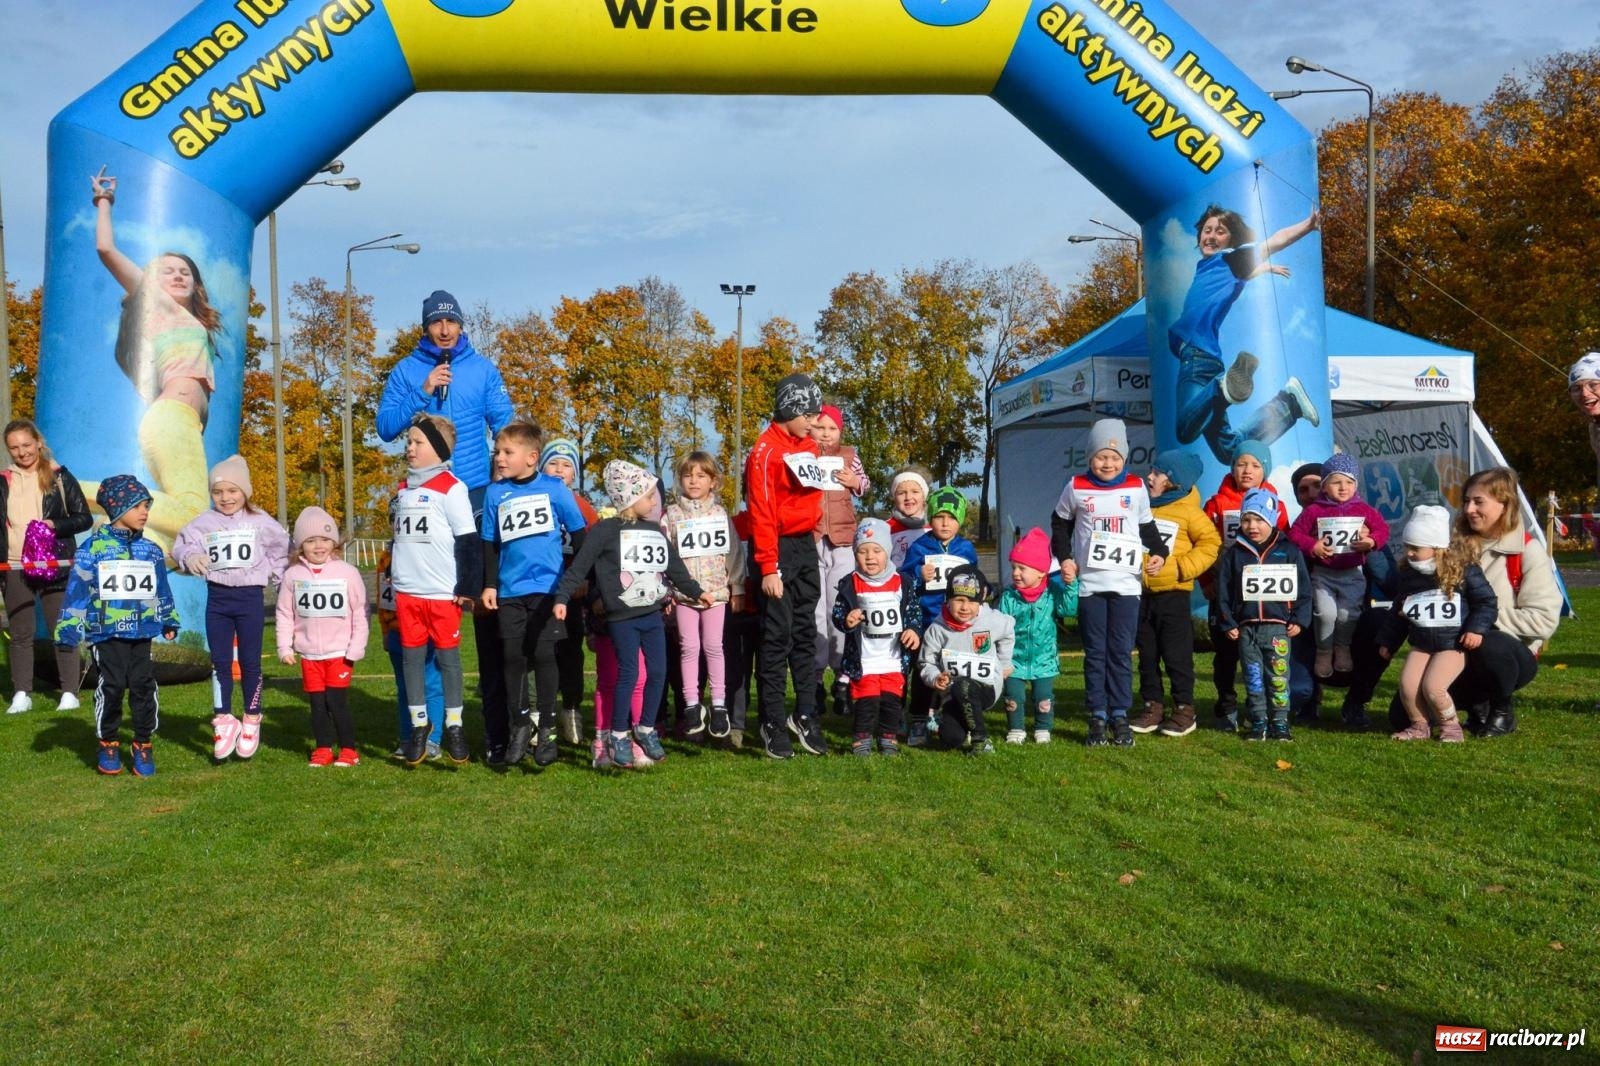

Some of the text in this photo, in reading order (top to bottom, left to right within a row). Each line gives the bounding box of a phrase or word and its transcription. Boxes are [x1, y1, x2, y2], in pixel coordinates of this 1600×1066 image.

[606, 0, 818, 33] Wielkie
[120, 22, 247, 119] Gmina
[169, 0, 373, 158] aktywnych
[1037, 4, 1224, 174] aktywnych
[1171, 51, 1266, 139] ludzi
[1415, 377, 1449, 388] MITKO
[798, 465, 822, 481] 469
[502, 507, 549, 531] 425
[681, 530, 726, 549] 405
[1322, 530, 1360, 547] 524
[209, 543, 251, 563] 510
[624, 545, 666, 564] 433
[1092, 544, 1136, 566] 541
[102, 574, 153, 592] 404
[1246, 577, 1294, 594] 520
[298, 593, 344, 610] 400
[1406, 602, 1457, 620] 419
[947, 661, 991, 679] 515
